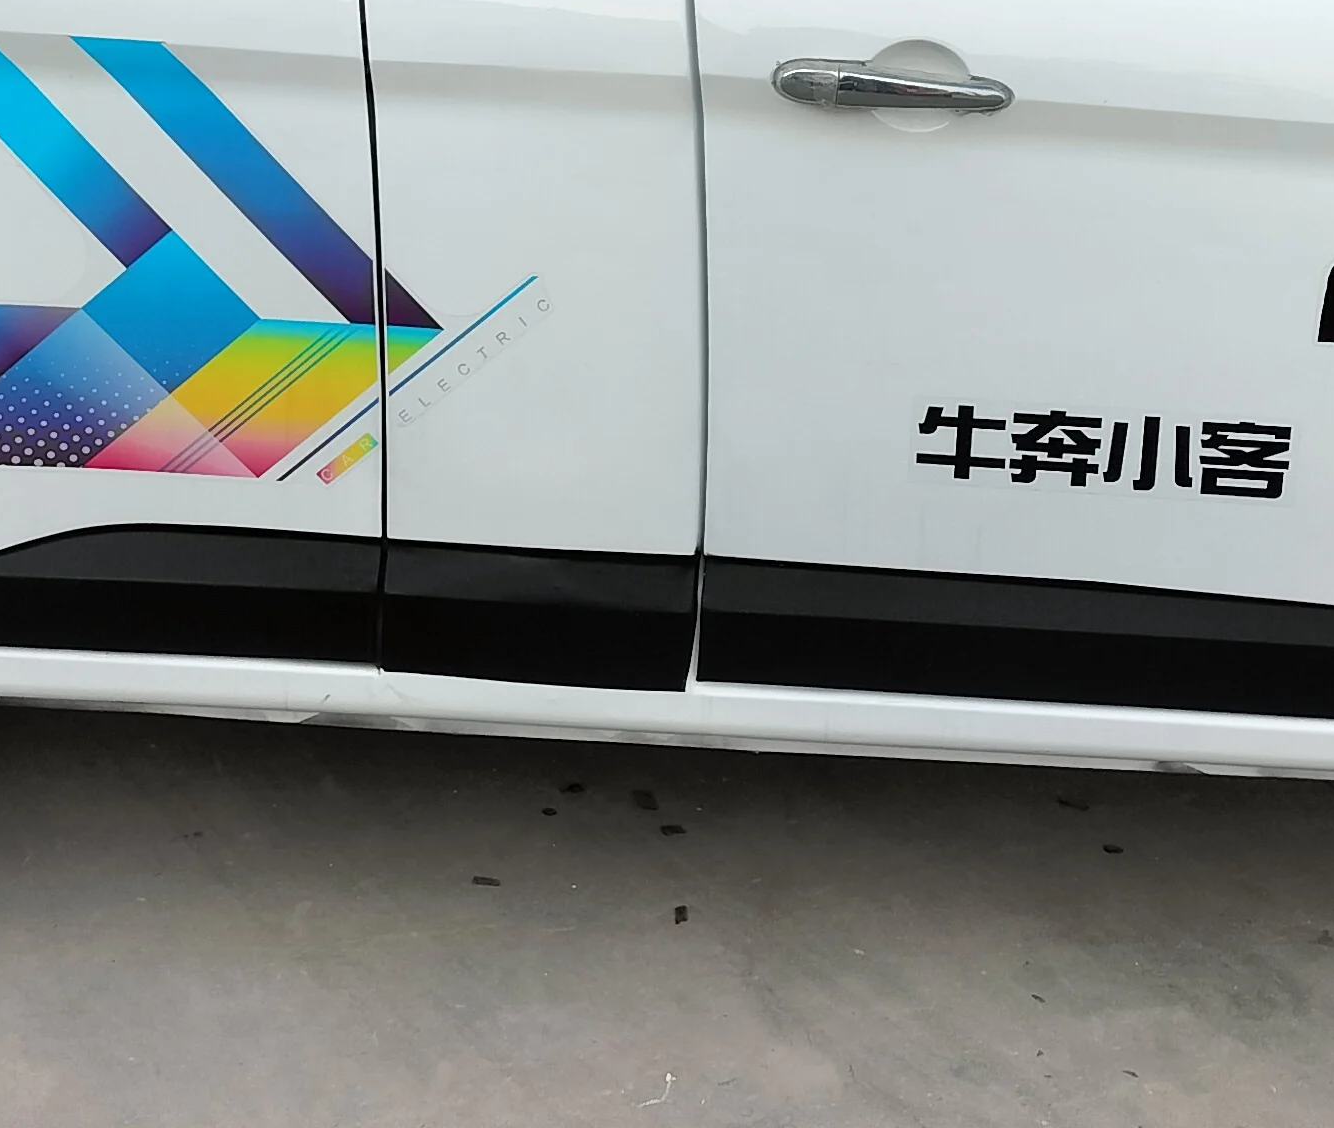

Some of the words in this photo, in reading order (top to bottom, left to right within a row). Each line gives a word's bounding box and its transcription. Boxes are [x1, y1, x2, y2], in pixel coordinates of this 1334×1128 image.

[320, 437, 374, 482] CAR
[398, 298, 551, 424] ELECTRIC
[916, 404, 1292, 499] 牛奔小客
